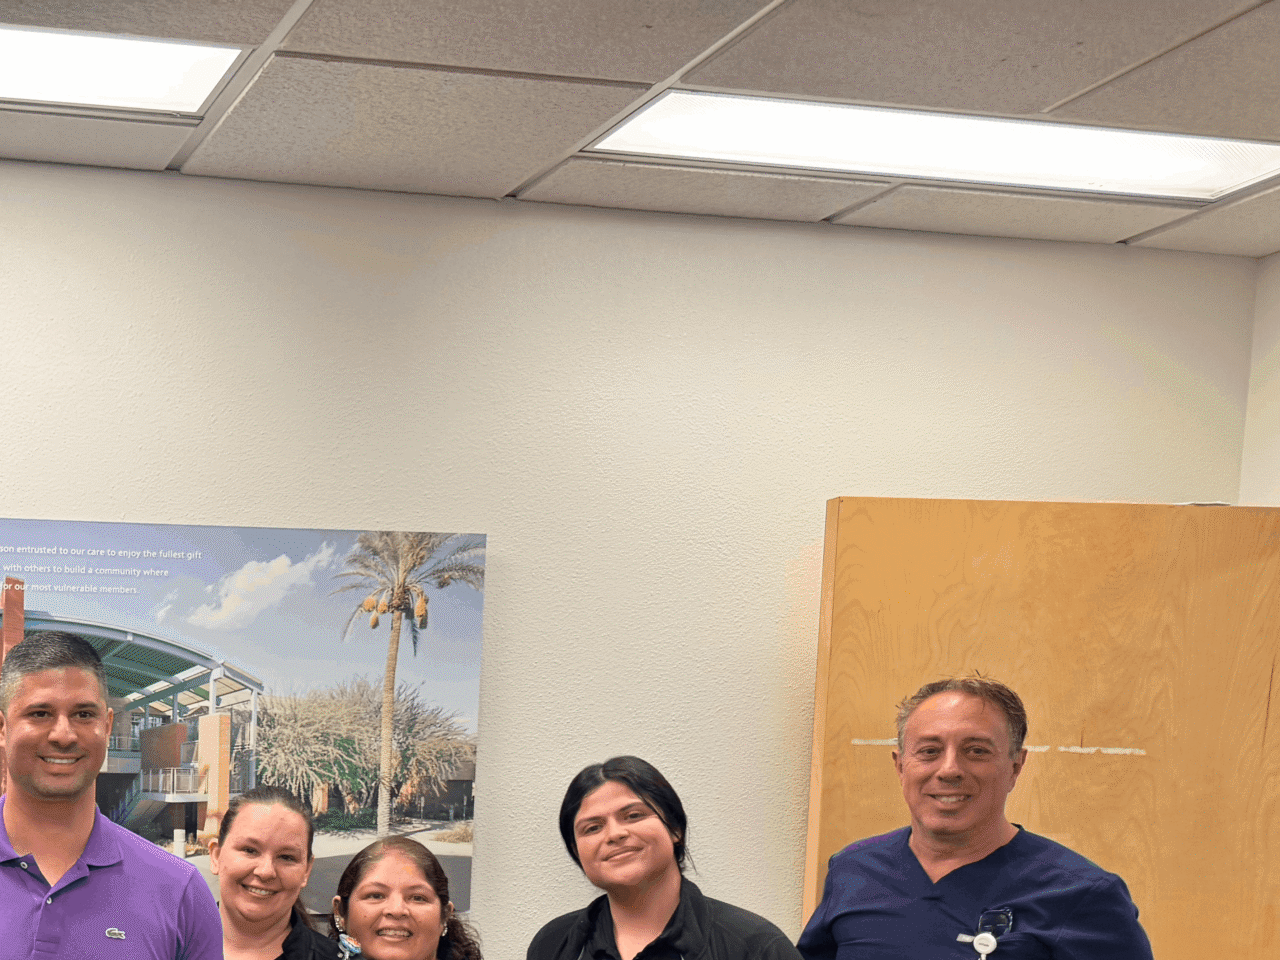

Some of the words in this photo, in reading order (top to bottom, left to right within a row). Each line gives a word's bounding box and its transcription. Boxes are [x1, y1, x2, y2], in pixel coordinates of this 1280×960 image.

[16, 545, 57, 555] entrusted
[59, 547, 69, 555] to
[70, 548, 85, 556] our
[107, 549, 116, 557] to
[118, 549, 141, 559] enjoy
[143, 549, 157, 558] the
[159, 550, 185, 559] fullest
[187, 551, 202, 560] gift
[3, 563, 22, 572] with
[24, 564, 51, 573] others
[53, 565, 63, 574] to
[64, 565, 86, 574] build
[95, 567, 141, 577] community
[143, 568, 169, 577] where
[0, 581, 13, 590] for
[14, 583, 30, 591] our
[31, 583, 52, 592] most
[53, 584, 98, 593] vulnerable
[99, 585, 140, 594] members.
